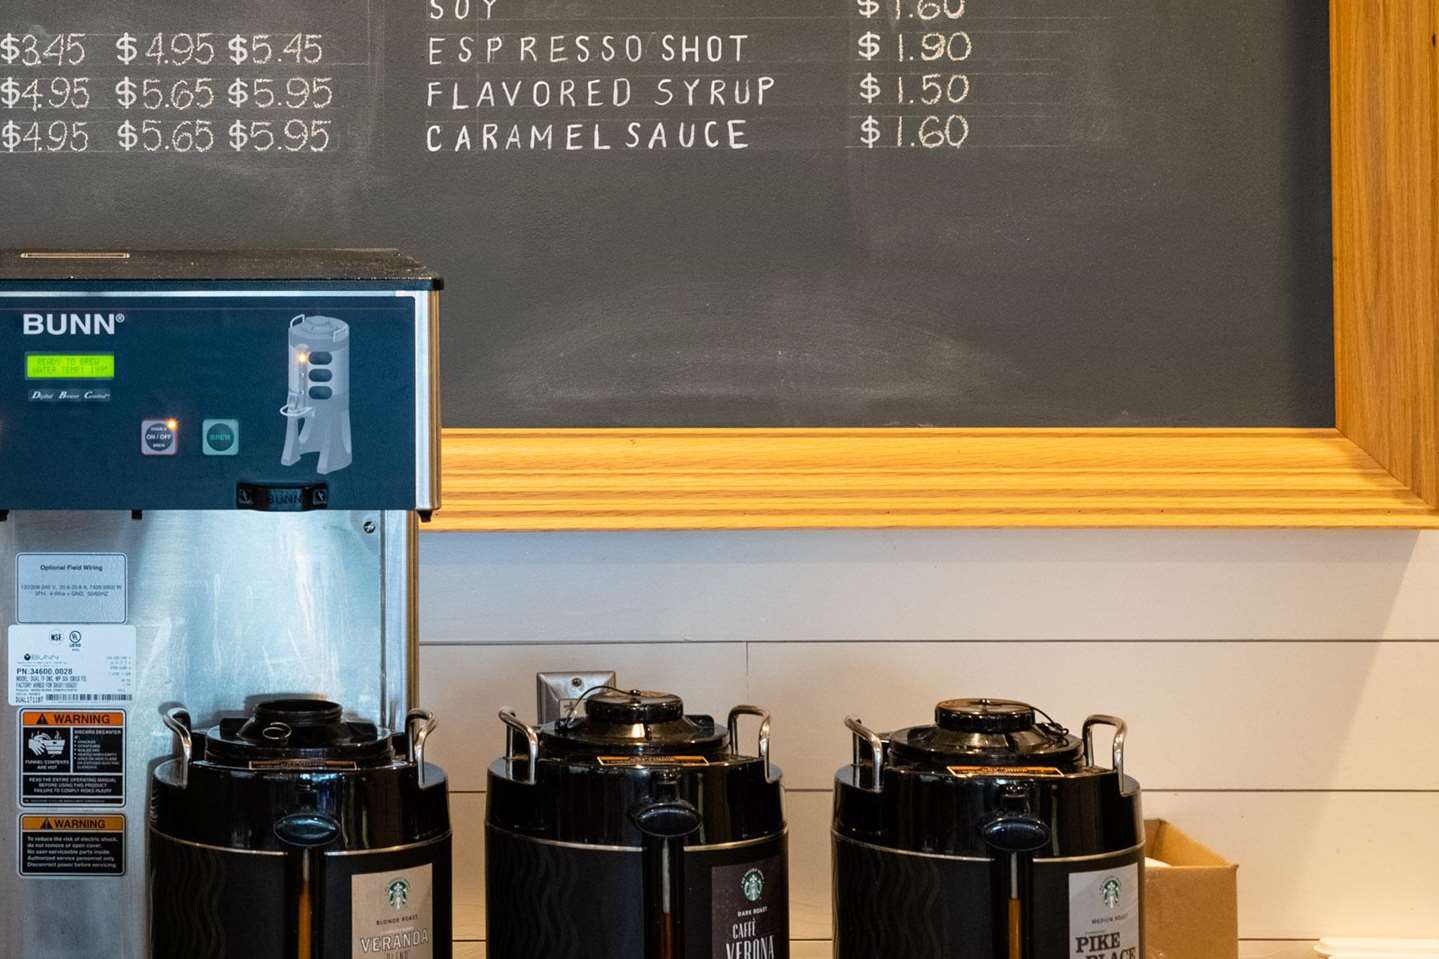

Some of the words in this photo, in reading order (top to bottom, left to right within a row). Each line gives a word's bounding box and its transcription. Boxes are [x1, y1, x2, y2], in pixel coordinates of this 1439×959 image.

[429, 35, 642, 65] ESPRESSO
[662, 34, 747, 62] SHOT
[858, 31, 972, 62] $1.90
[428, 78, 630, 110] FLAVORED
[655, 77, 774, 105] SYRUP
[860, 73, 969, 105] $1.50
[427, 124, 610, 152] CARAMEL
[626, 120, 748, 149] SAUCE
[861, 115, 968, 148] $1.60
[40, 564, 66, 572] Optional
[83, 564, 103, 572] Wiring
[54, 714, 110, 724] WARNING
[53, 819, 106, 829] WARNING
[737, 909, 752, 917] DARK
[360, 928, 429, 953] VERANDA
[1075, 931, 1120, 953] PIKE
